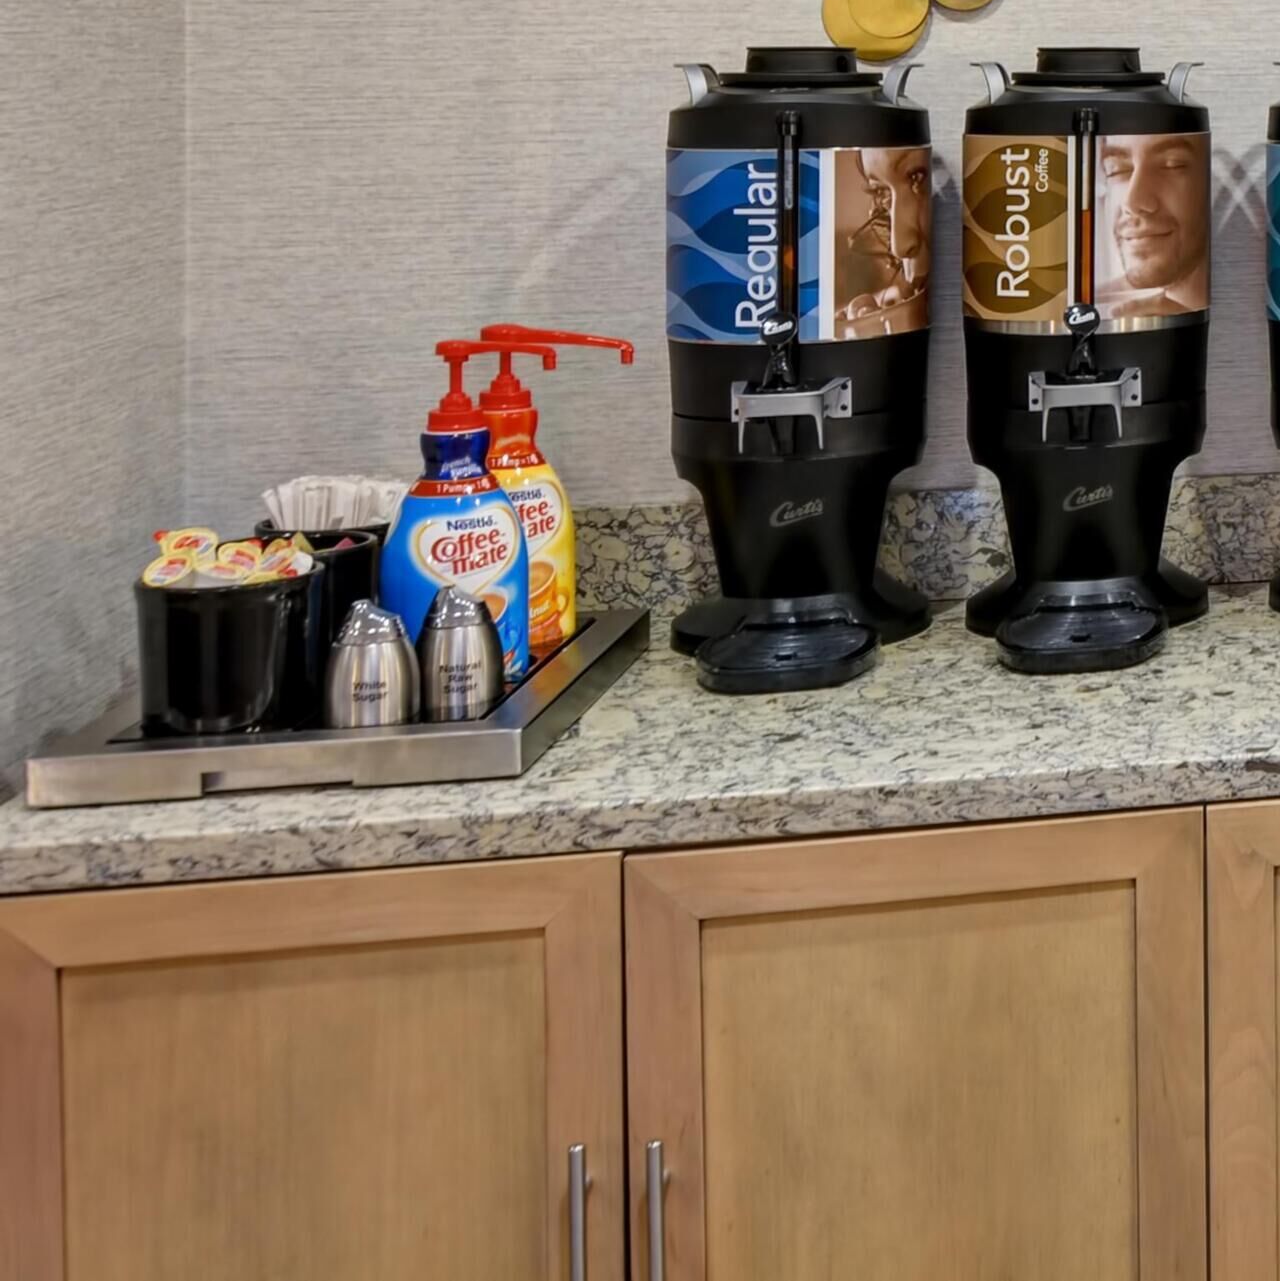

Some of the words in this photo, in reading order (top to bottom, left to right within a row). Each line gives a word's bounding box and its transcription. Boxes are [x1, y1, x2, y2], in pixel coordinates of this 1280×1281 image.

[1035, 149, 1049, 193] Coffee
[995, 148, 1030, 297] Robust
[733, 163, 778, 328] Regular
[446, 516, 494, 532] Nestlé
[527, 515, 555, 538] ate
[452, 543, 508, 575] mate
[439, 660, 482, 673] Natural
[353, 680, 387, 690] White
[447, 674, 474, 683] Raw
[444, 682, 478, 695] Sugar
[353, 691, 389, 703] Sugar
